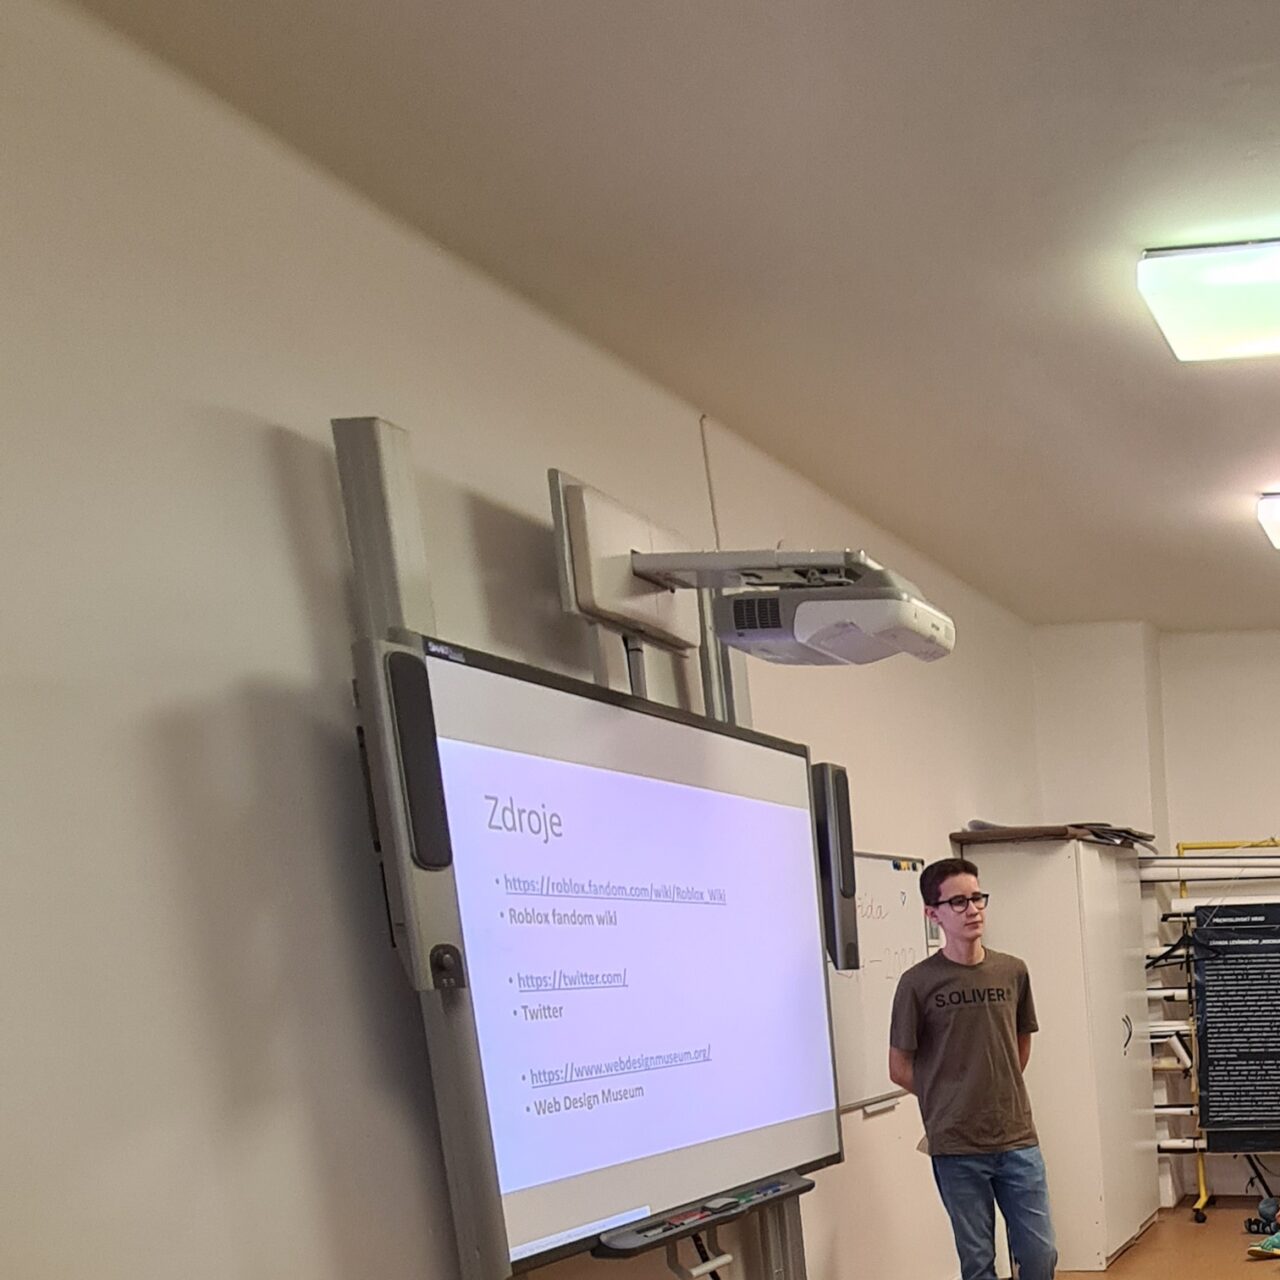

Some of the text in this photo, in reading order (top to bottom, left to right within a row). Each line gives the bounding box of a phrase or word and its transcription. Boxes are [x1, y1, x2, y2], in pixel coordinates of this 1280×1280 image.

[484, 795, 563, 844] Zdroje
[503, 874, 727, 905] https://roblox.fandom.com/wiki/Roblox_Wiki
[508, 908, 618, 926] Roblox fandom wiki
[517, 968, 629, 992] https://twitter.com/
[935, 987, 1006, 1008] S.OLIVER
[521, 1003, 564, 1021] Twitter
[530, 1044, 712, 1089] https://www.webdesignmuseum.org/
[534, 1085, 644, 1116] Web Design Museum
